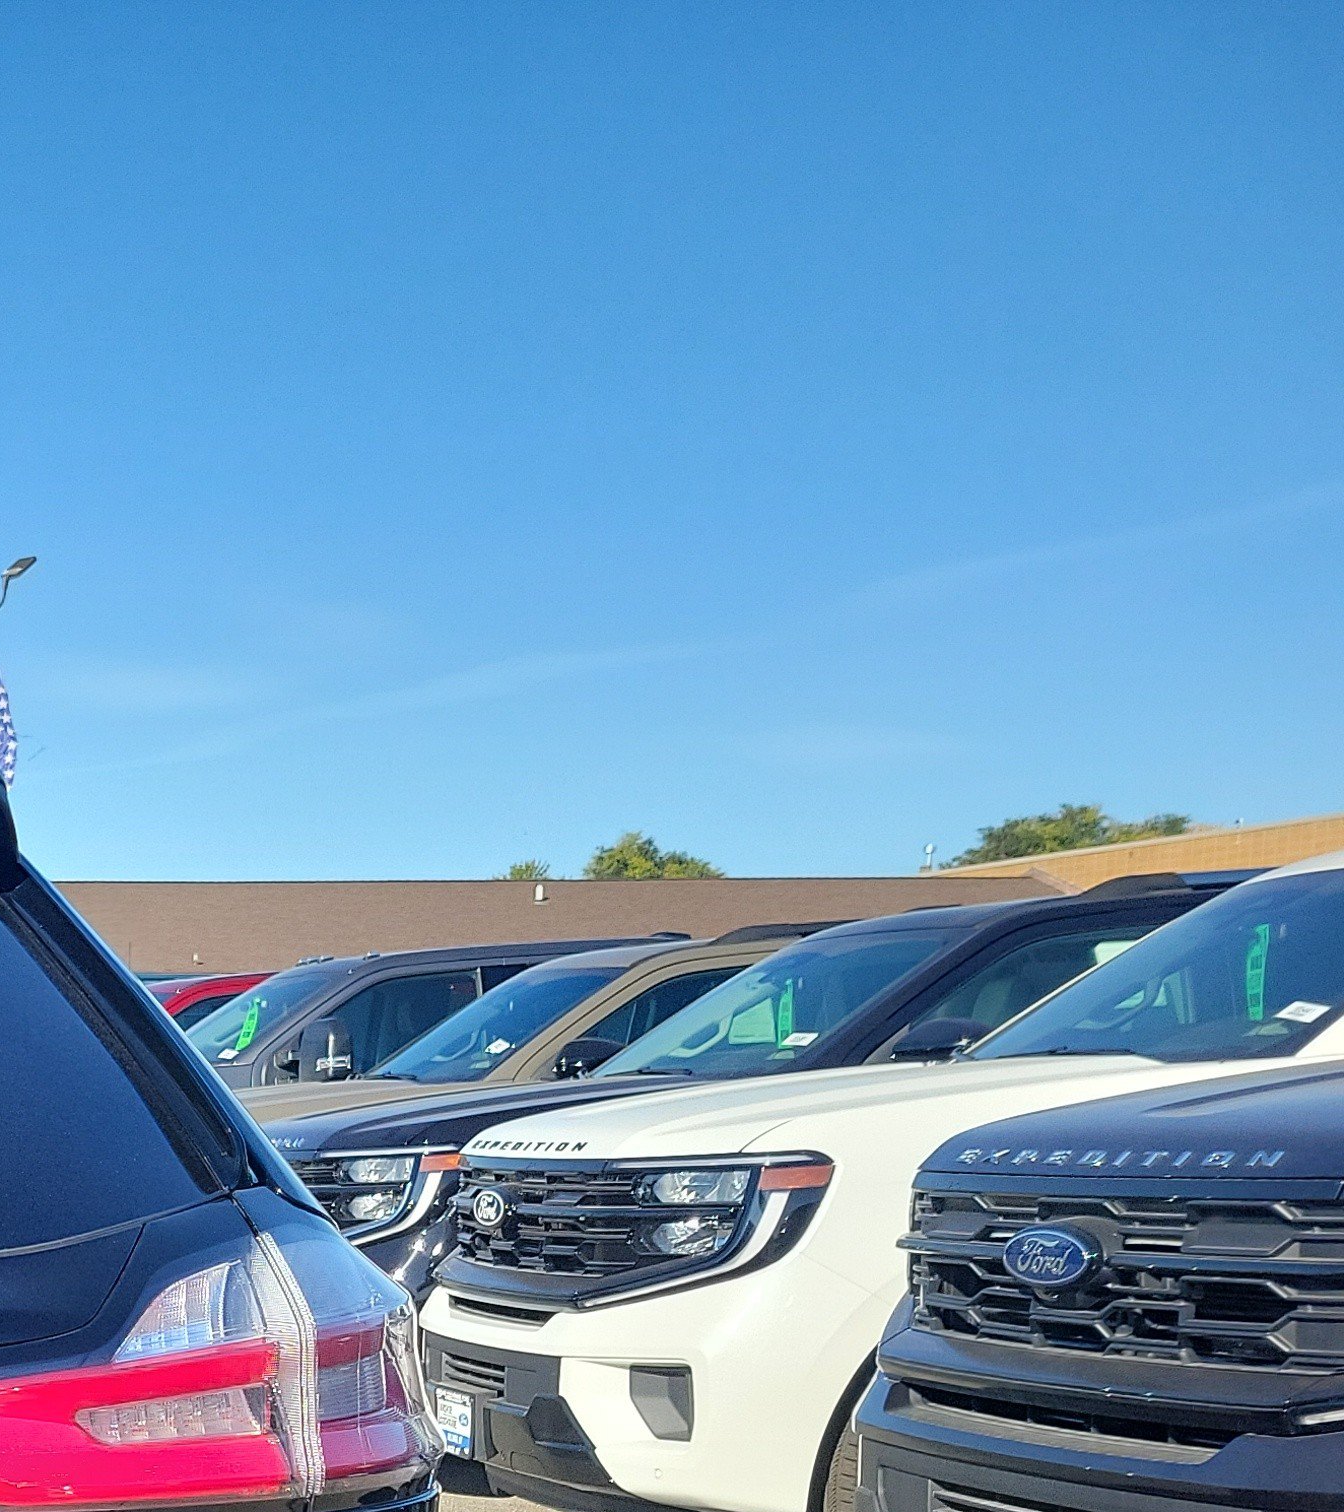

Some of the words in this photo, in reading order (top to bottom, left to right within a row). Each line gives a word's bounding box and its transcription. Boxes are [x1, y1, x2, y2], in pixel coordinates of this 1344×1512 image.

[472, 1140, 588, 1152] EXPEDITION
[955, 1148, 1286, 1168] EXPEDITION
[1016, 1237, 1074, 1276] Ford
